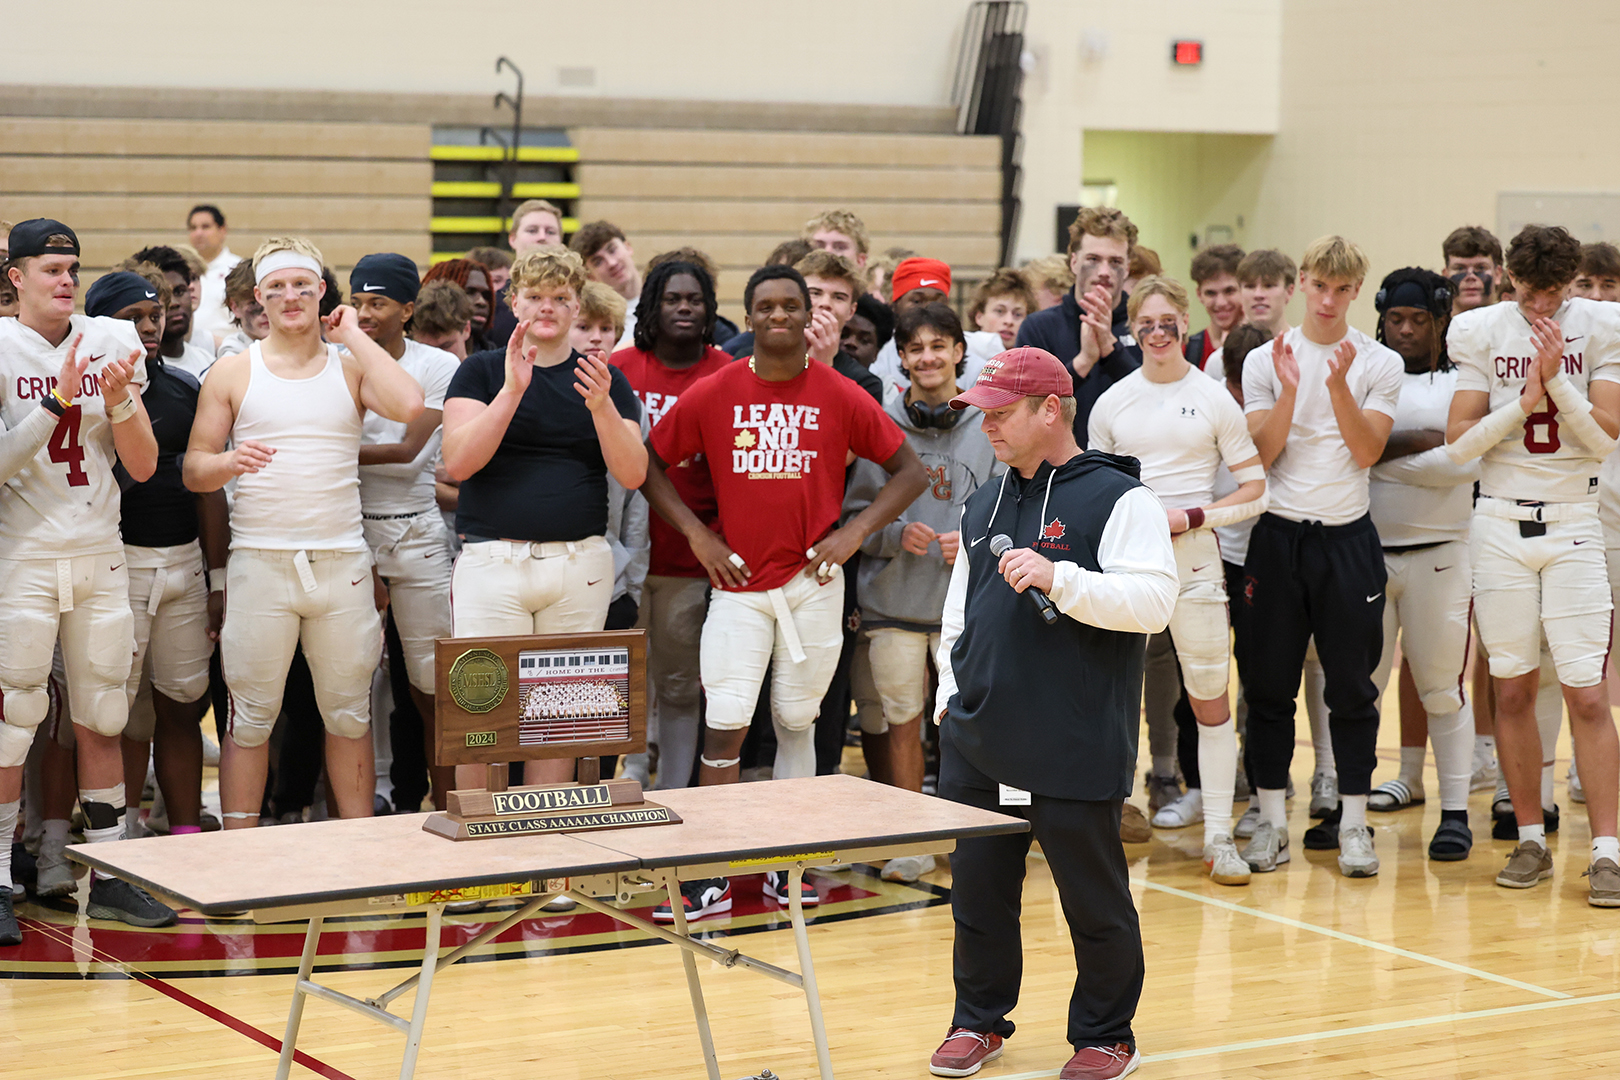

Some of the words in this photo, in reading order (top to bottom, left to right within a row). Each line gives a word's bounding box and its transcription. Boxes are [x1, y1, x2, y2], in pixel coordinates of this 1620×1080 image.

[733, 403, 820, 430] LEAVE
[1520, 381, 1561, 454] 8
[47, 404, 90, 487] 4
[757, 426, 799, 450] NO
[732, 450, 818, 473] DOUBT
[1032, 542, 1071, 551] FOTBALL
[463, 672, 497, 687] MSHSL
[469, 733, 494, 744] 2024
[495, 787, 610, 812] FOOTBALL
[469, 821, 506, 835] STATE
[508, 818, 547, 832] CLASS
[549, 814, 599, 828] AAAAAA
[601, 809, 666, 825] CHAMPION
